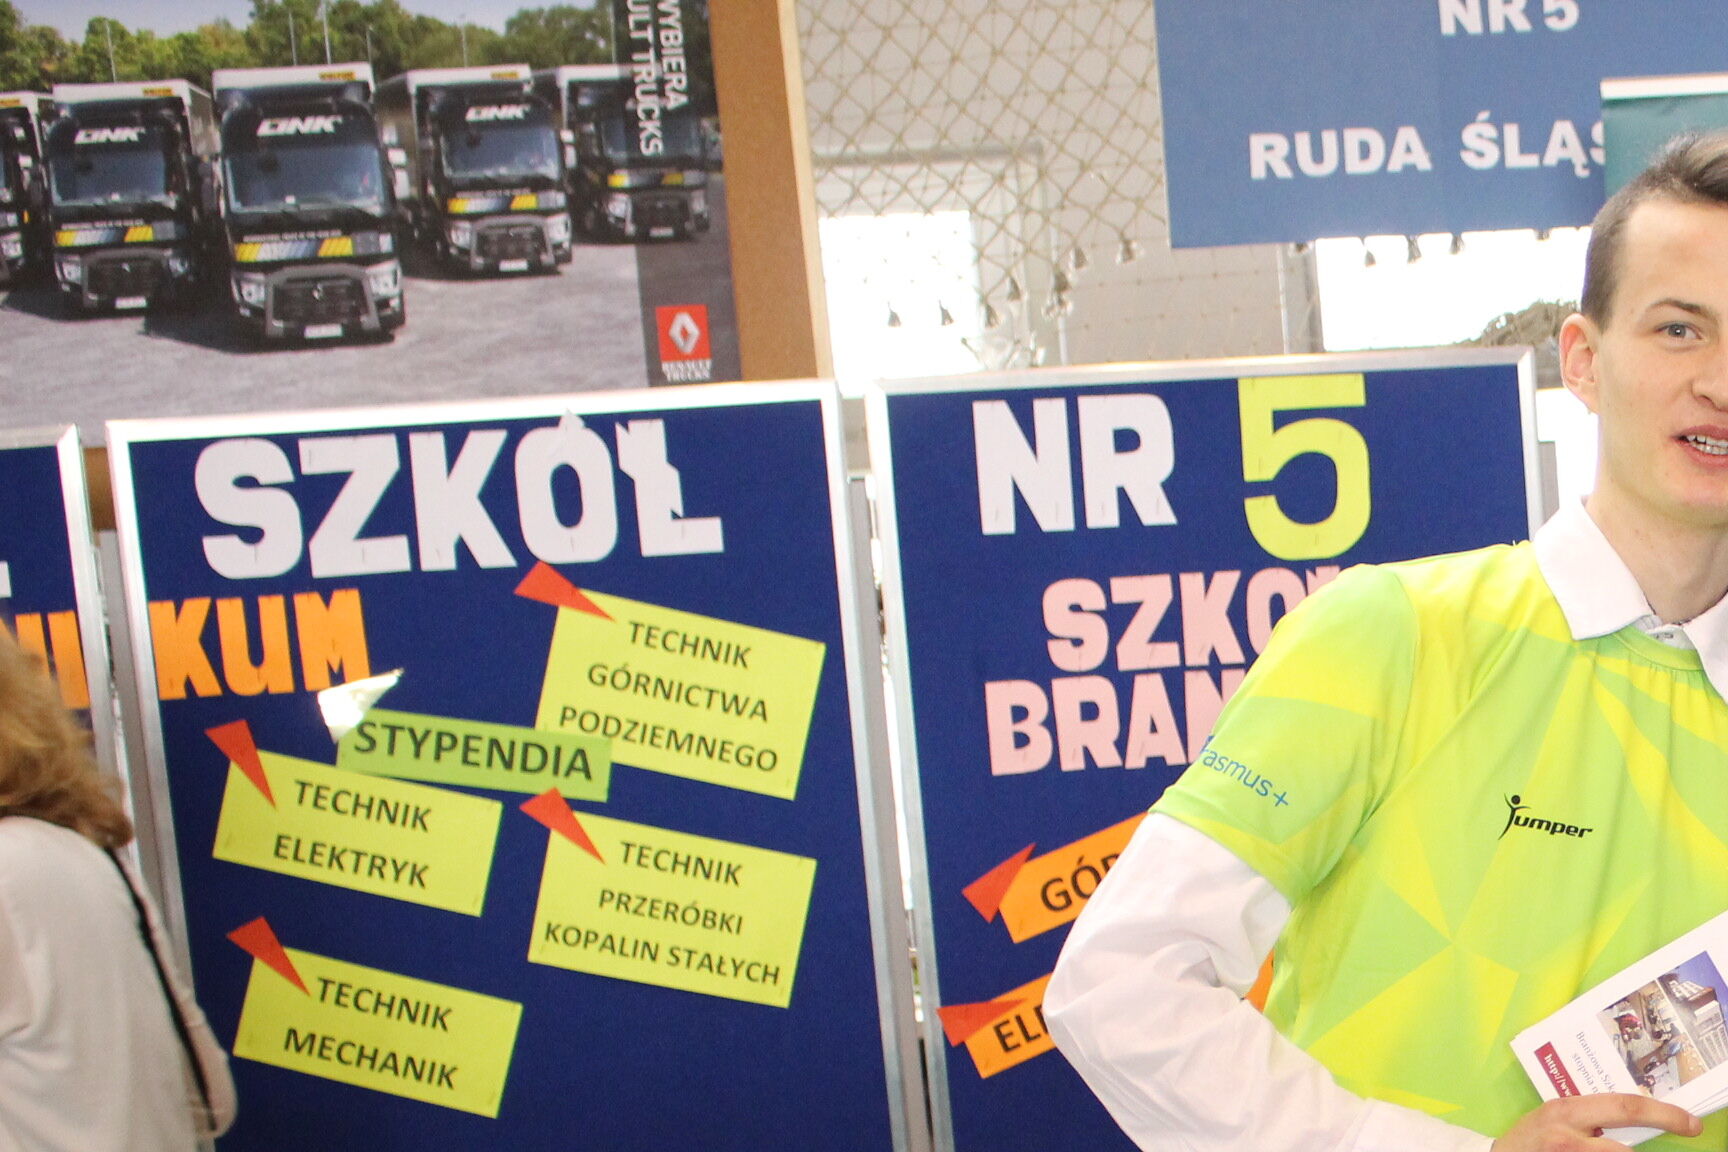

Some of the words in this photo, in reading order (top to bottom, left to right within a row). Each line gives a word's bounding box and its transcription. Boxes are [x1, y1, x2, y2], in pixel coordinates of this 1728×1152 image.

[1439, 0, 1532, 35] NR
[1543, 0, 1580, 31] 5
[631, 47, 664, 157] TRUCKS
[1249, 125, 1433, 179] RUDA
[194, 409, 724, 579] SZKÓŁ
[971, 393, 1178, 535] NR
[1237, 373, 1372, 561] 5
[148, 588, 371, 701] KUM
[628, 620, 753, 669] TECHNIK
[1042, 565, 1341, 672] SZKO
[587, 662, 769, 722] GÓRNICTWA
[354, 720, 593, 781] STYPENDIA
[559, 705, 778, 772] PODZIEMNEGO
[294, 779, 432, 833] TECHNIK
[273, 834, 430, 890] ELEKTRYK
[620, 840, 743, 888] TECHNIK
[598, 888, 743, 936] PRZERÓBKI
[544, 921, 660, 962] KOPALIN
[666, 946, 780, 986] STAŁYCH
[317, 976, 453, 1031] TECHNIK
[284, 1027, 459, 1090] MECHANIK
